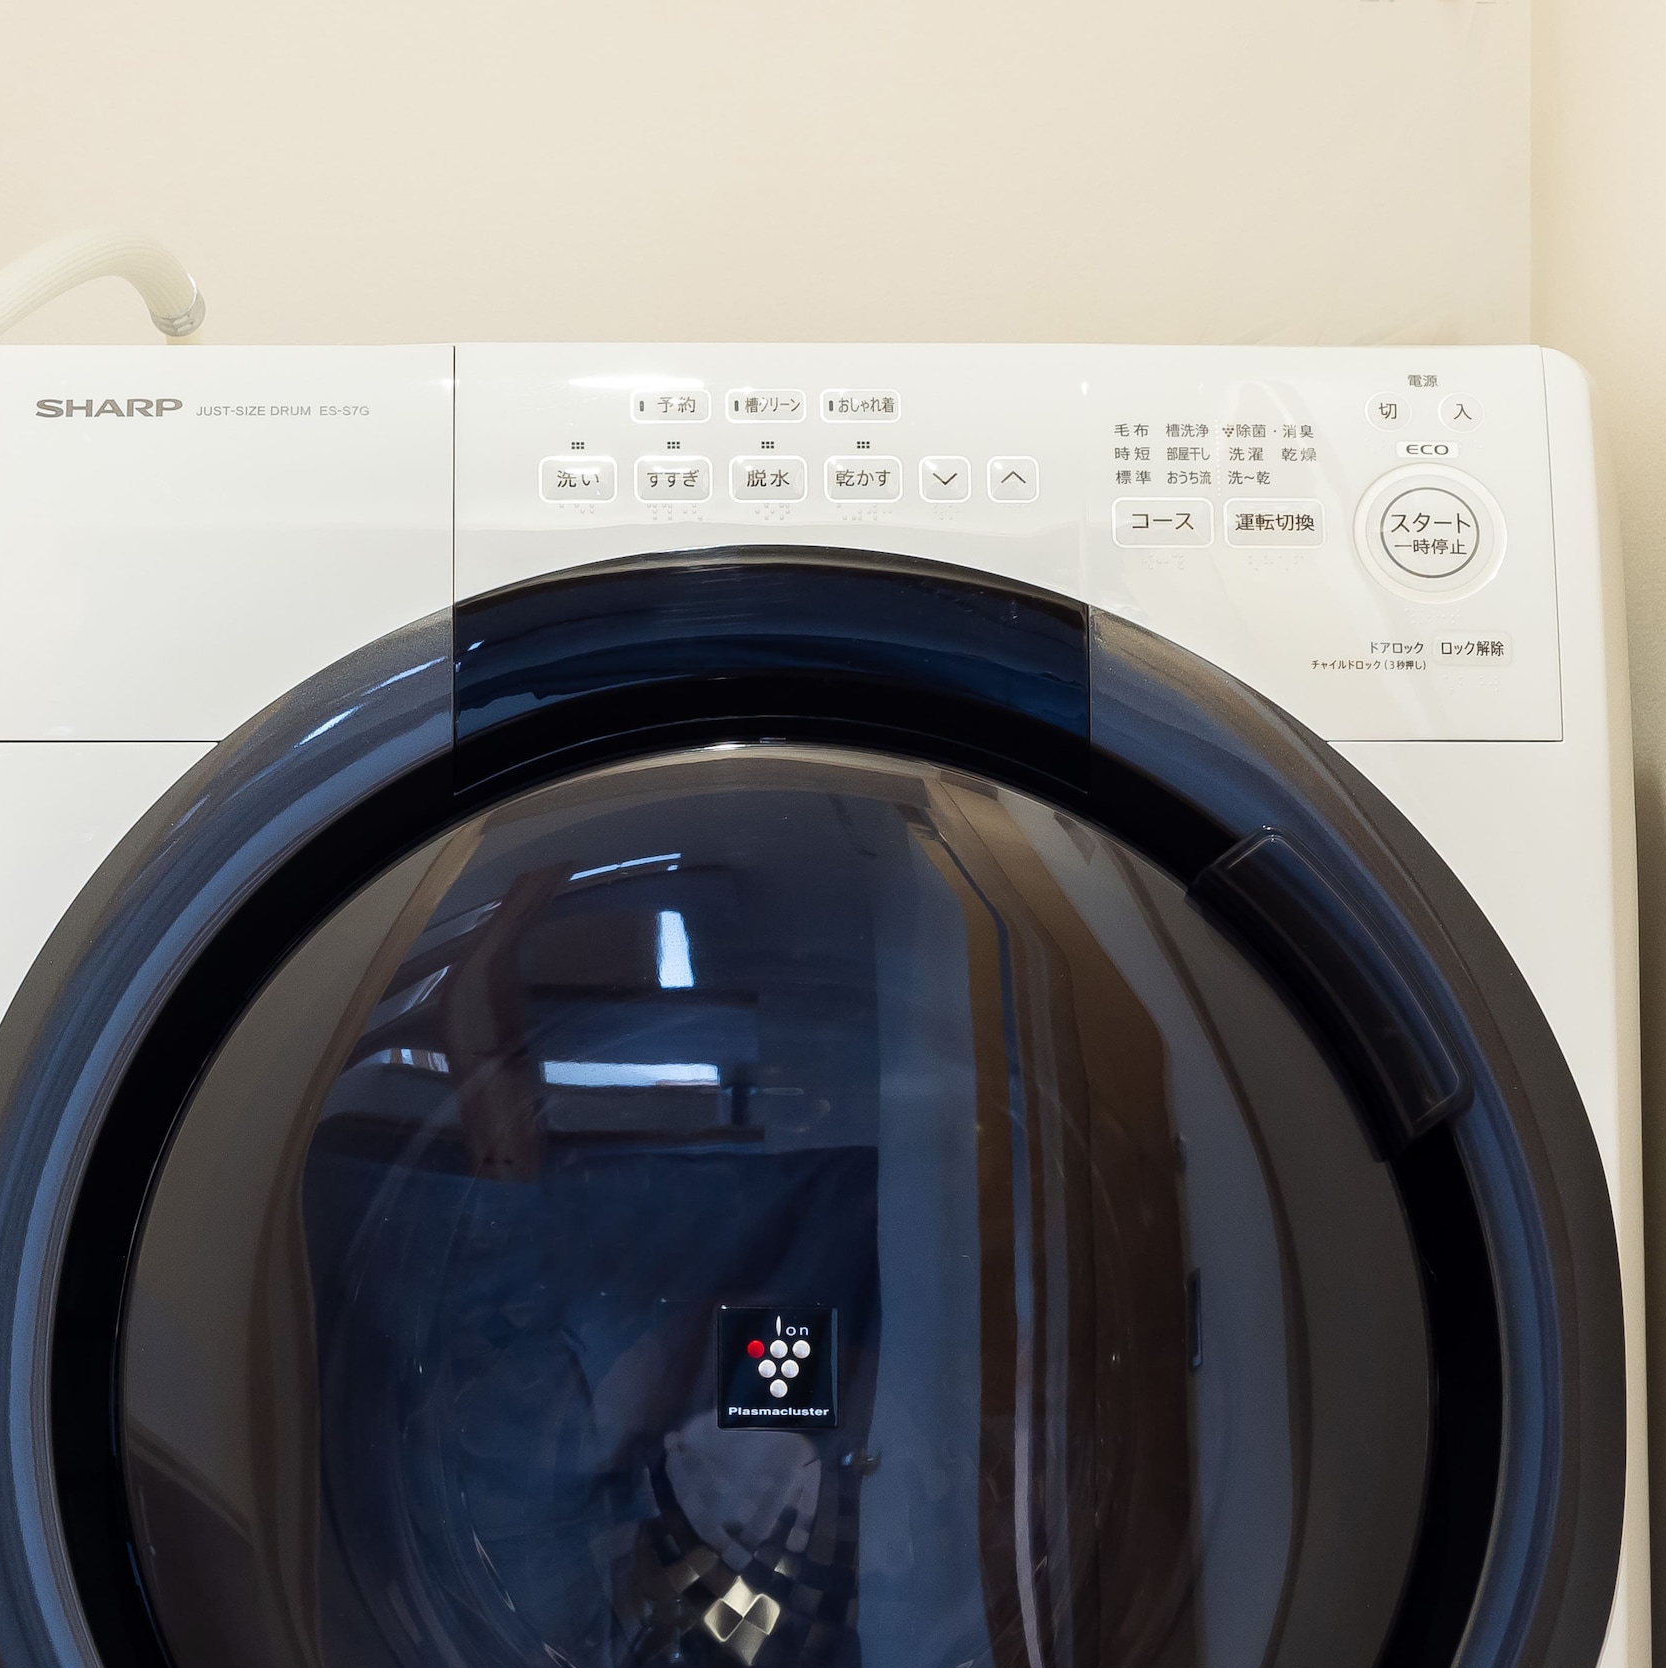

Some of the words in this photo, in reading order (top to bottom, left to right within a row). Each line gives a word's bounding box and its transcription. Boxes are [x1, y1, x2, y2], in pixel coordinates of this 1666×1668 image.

[1408, 375, 1438, 387] 電源
[36, 399, 182, 418] SHARP
[196, 406, 265, 416] JUST-SIZE
[271, 406, 310, 415] DRUM
[657, 397, 695, 413] 予約
[745, 397, 800, 413] 槽クリーン
[839, 397, 894, 413] おしゃれ着
[1379, 403, 1397, 419] 切
[1454, 404, 1472, 420] 入
[1114, 423, 1149, 437] 毛布
[1166, 424, 1209, 437] 槽洗浄
[1115, 447, 1150, 460] 時短
[1167, 447, 1210, 461] 部屋干し
[1229, 447, 1263, 461] 洗濯
[1282, 448, 1316, 461] 乾燥
[1406, 445, 1448, 455] ECO
[557, 471, 599, 487] 洗い
[647, 470, 699, 487] すすぎ
[747, 470, 789, 487] 脱水
[836, 469, 890, 487] 乾かす
[1116, 470, 1151, 484] 標準
[1167, 471, 1211, 484] おうち流
[1132, 513, 1194, 530] コース
[1236, 514, 1314, 531] 運転切換
[1390, 512, 1471, 533] スタート
[1395, 539, 1467, 554] 一時停止
[1371, 642, 1423, 654] ドアロック
[1442, 641, 1504, 656] ロック解除
[729, 1407, 829, 1416] Plasmacluster
